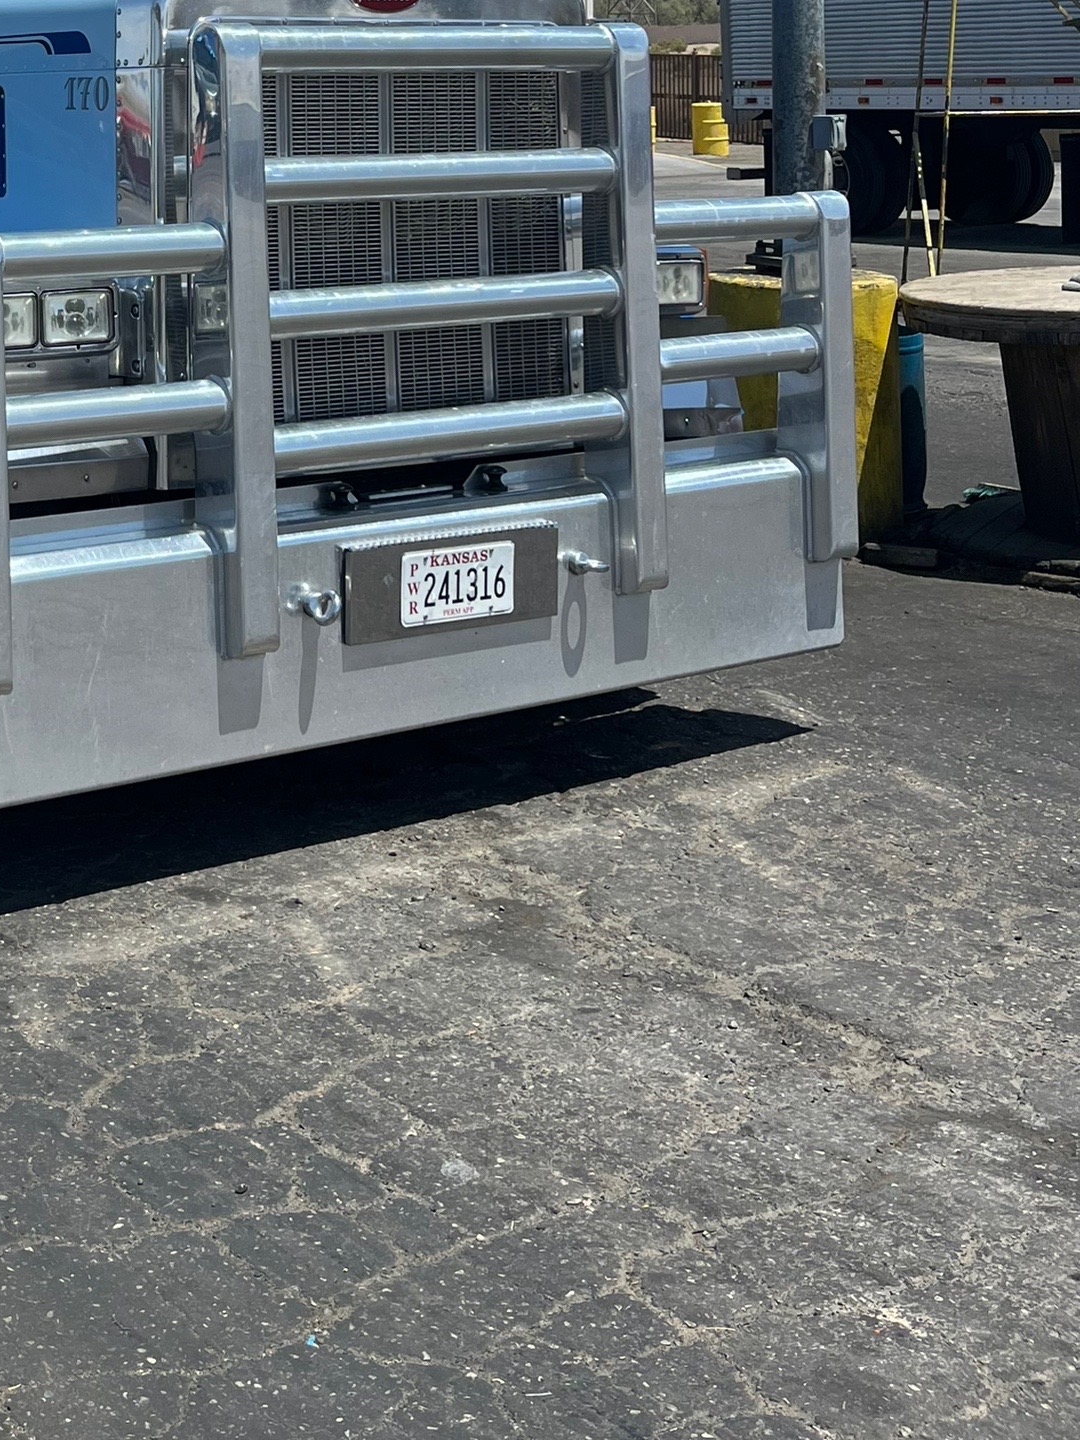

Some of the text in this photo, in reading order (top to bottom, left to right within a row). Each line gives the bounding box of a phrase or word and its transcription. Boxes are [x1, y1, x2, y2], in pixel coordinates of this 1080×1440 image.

[63, 76, 110, 112] 170
[429, 549, 488, 568] KANSAS
[423, 564, 506, 608] 241316
[442, 606, 474, 617] PERM APP
